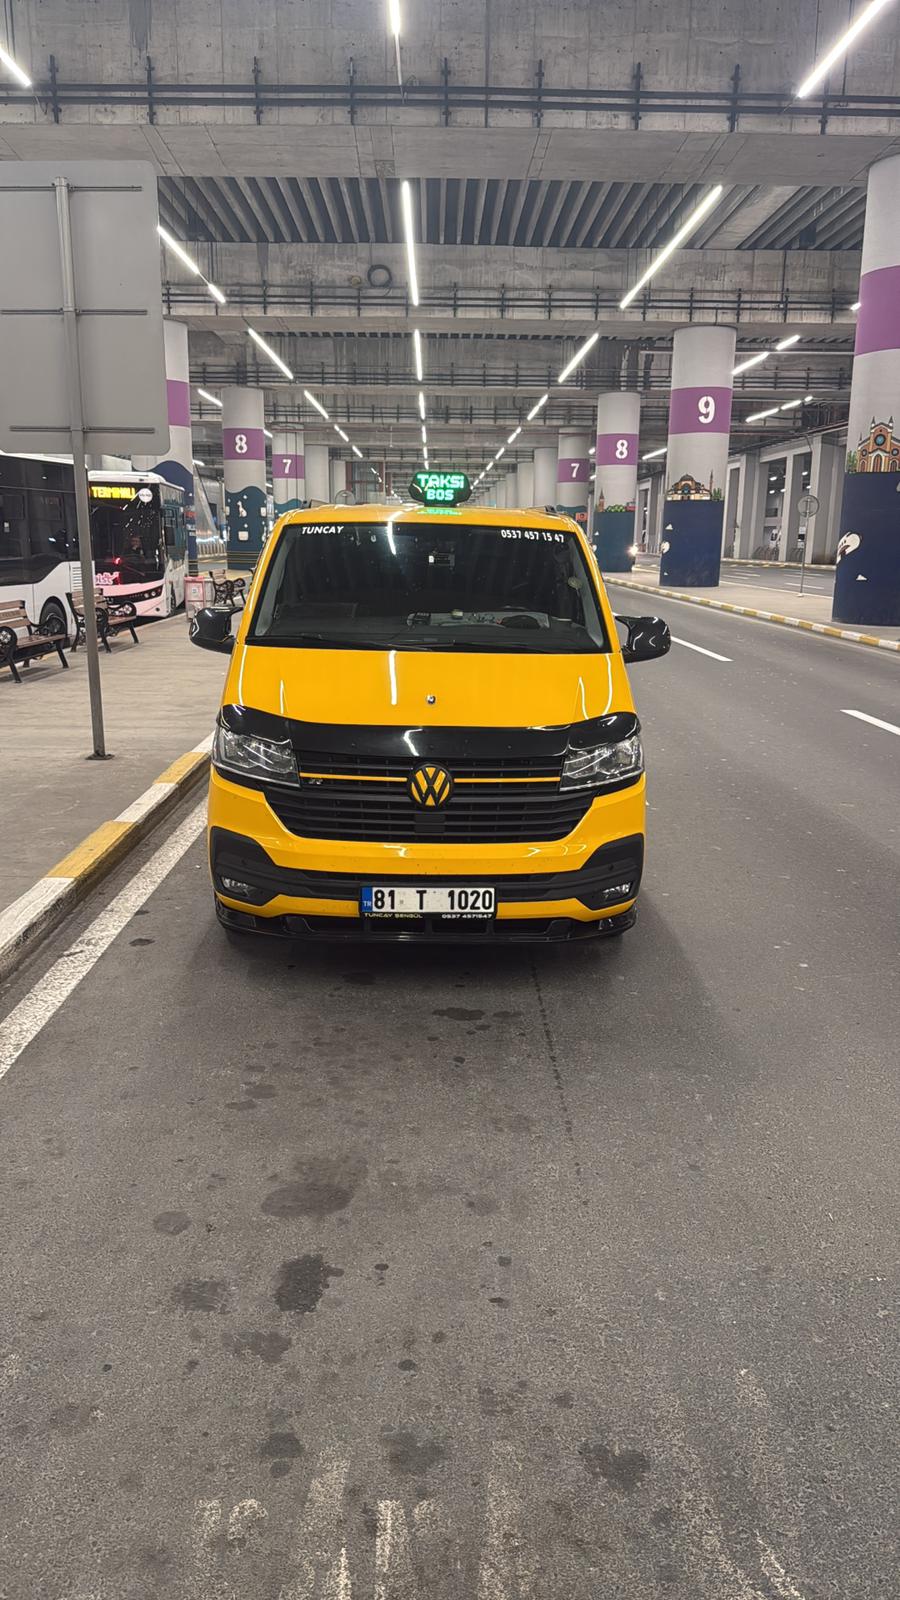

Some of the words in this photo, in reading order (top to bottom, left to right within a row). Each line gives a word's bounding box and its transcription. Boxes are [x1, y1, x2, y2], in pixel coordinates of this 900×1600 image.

[697, 396, 715, 424] 9
[234, 434, 248, 454] 8
[615, 439, 628, 459] 8
[282, 459, 291, 474] 7
[570, 463, 580, 478] 7
[301, 525, 345, 535] TUNCAY
[500, 529, 522, 539] 0537
[524, 530, 539, 540] 457
[542, 532, 553, 542] 15
[554, 533, 564, 543] 47
[373, 888, 396, 910] 81
[416, 889, 427, 910] T
[447, 889, 494, 911] 1020
